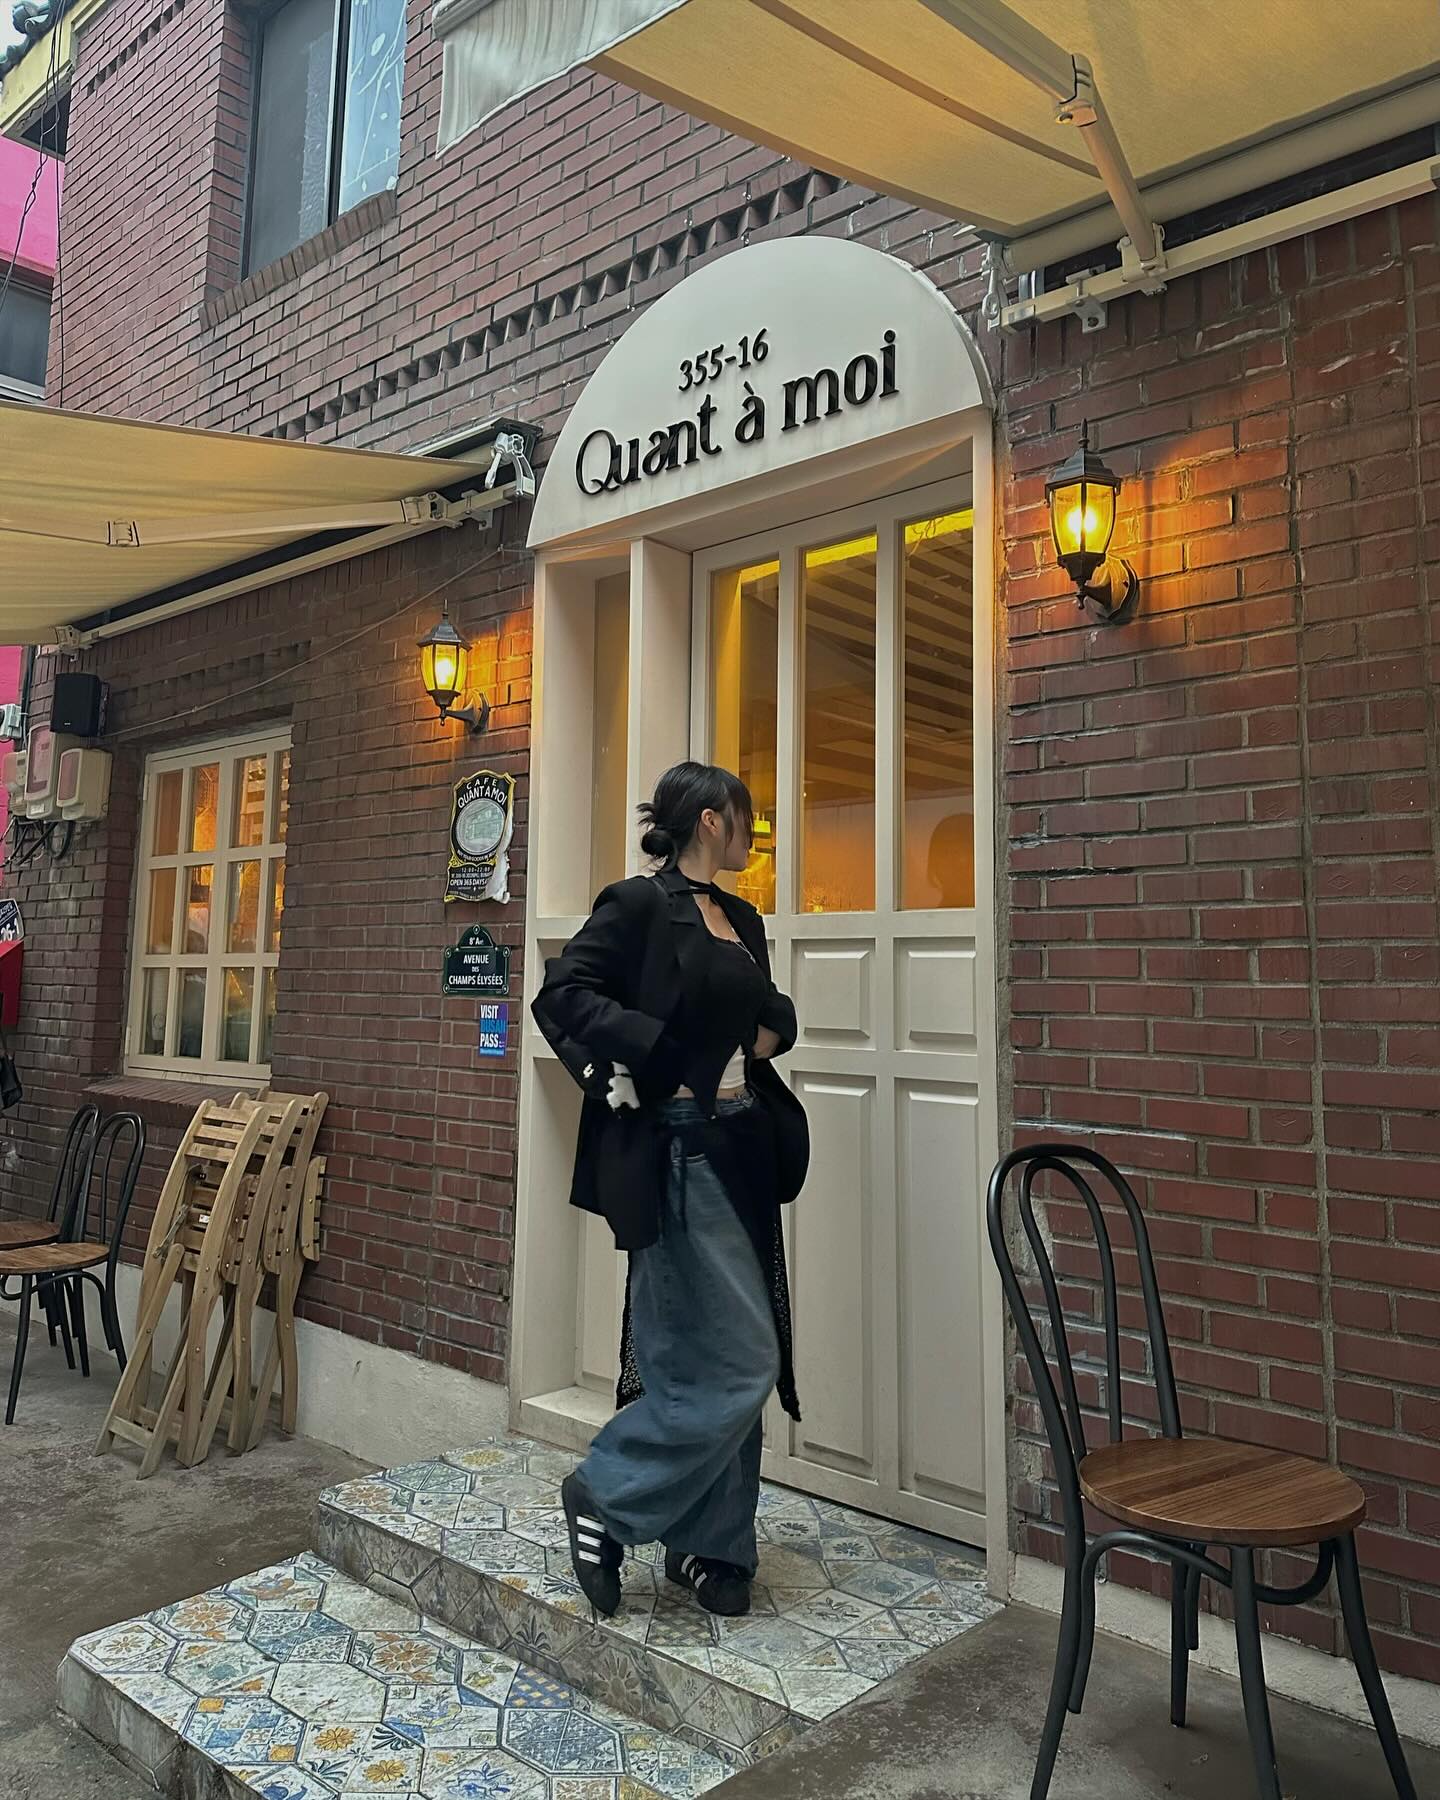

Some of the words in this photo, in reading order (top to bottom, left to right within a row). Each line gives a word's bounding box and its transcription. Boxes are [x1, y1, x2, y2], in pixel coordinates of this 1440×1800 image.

[679, 328, 768, 392] 355-16
[575, 394, 722, 495] Quant
[734, 381, 765, 443] à
[780, 329, 899, 431] moi
[466, 777, 497, 790] CAFE
[463, 954, 489, 964] AVENUE
[448, 975, 476, 985] CHAMPS
[477, 973, 503, 985] ÉLYSÉES
[480, 1004, 499, 1019] VISIT
[480, 1033, 499, 1048] PASS
